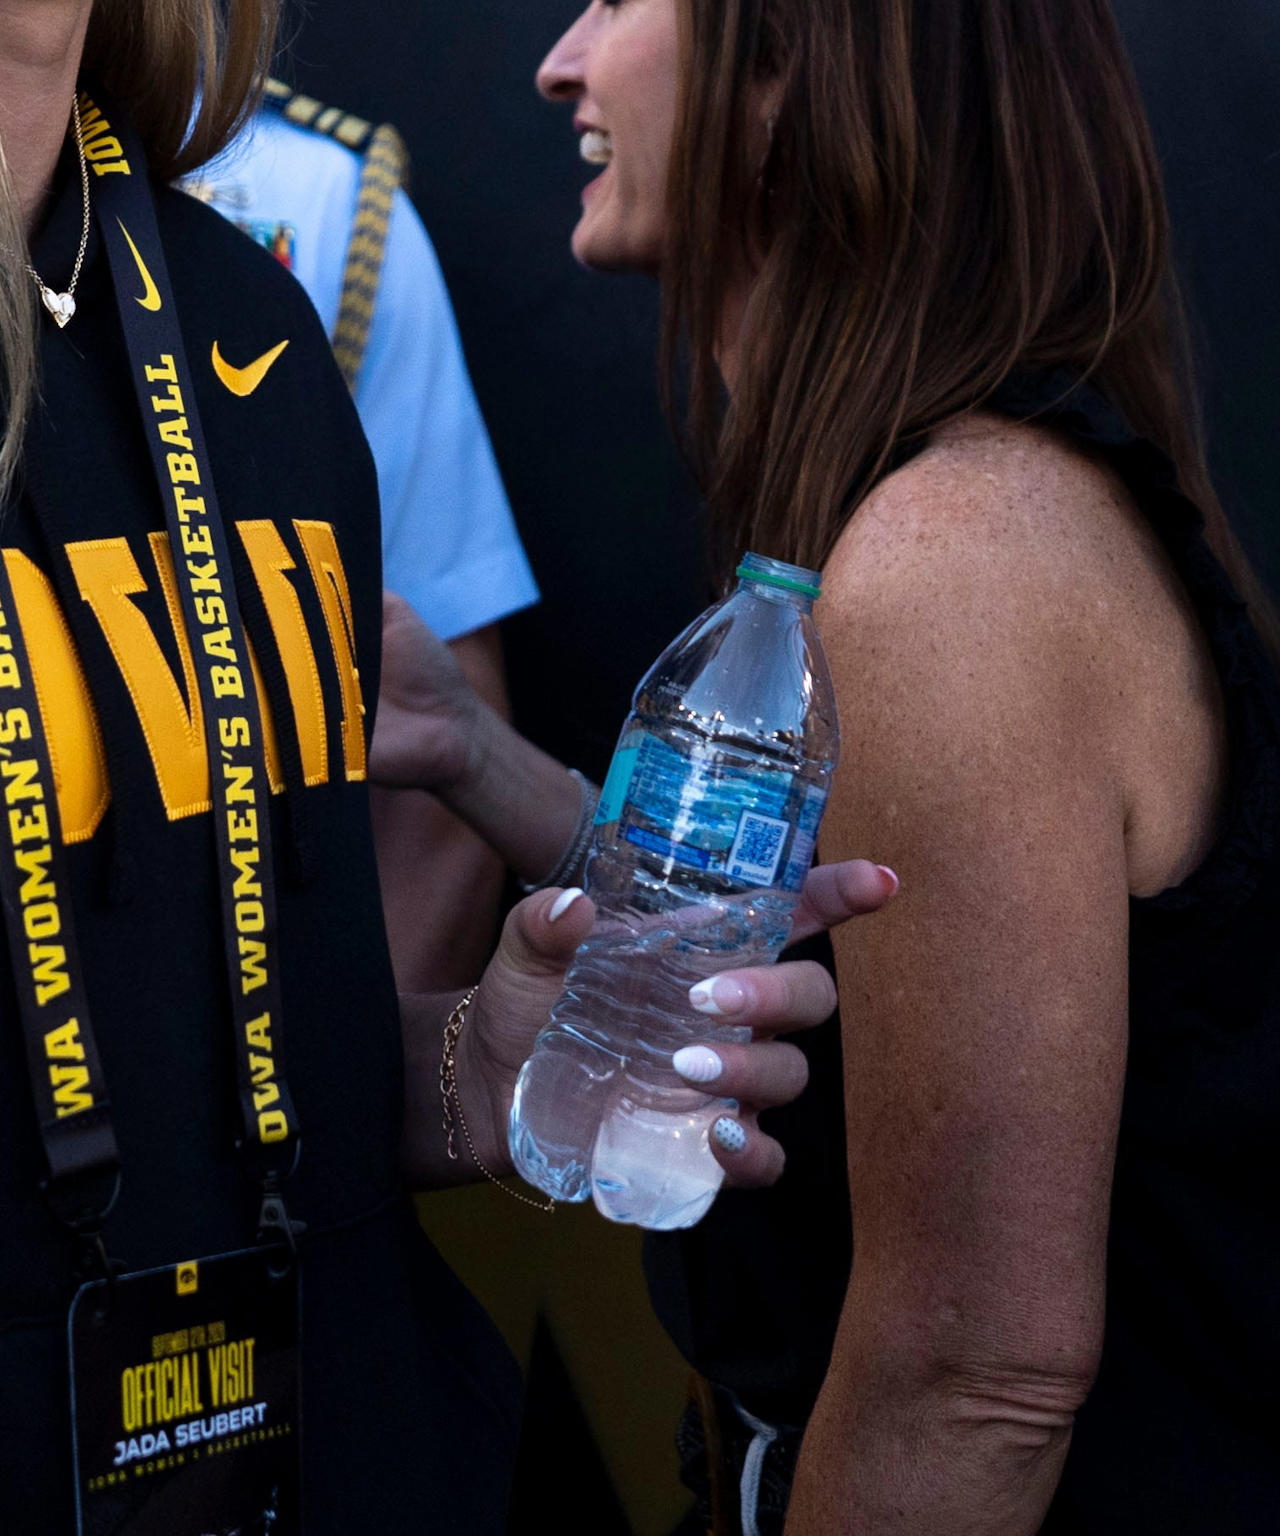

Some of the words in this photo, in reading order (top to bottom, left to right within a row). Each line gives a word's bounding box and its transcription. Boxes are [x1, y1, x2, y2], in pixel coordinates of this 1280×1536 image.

[145, 355, 244, 696] BASKETBALL
[219, 718, 269, 995] WOMEN'S
[112, 1429, 171, 1467] JADA
[173, 1401, 268, 1449] SEUBERT
[122, 1352, 203, 1432] OFFICIAL
[208, 1338, 256, 1407] VISIT
